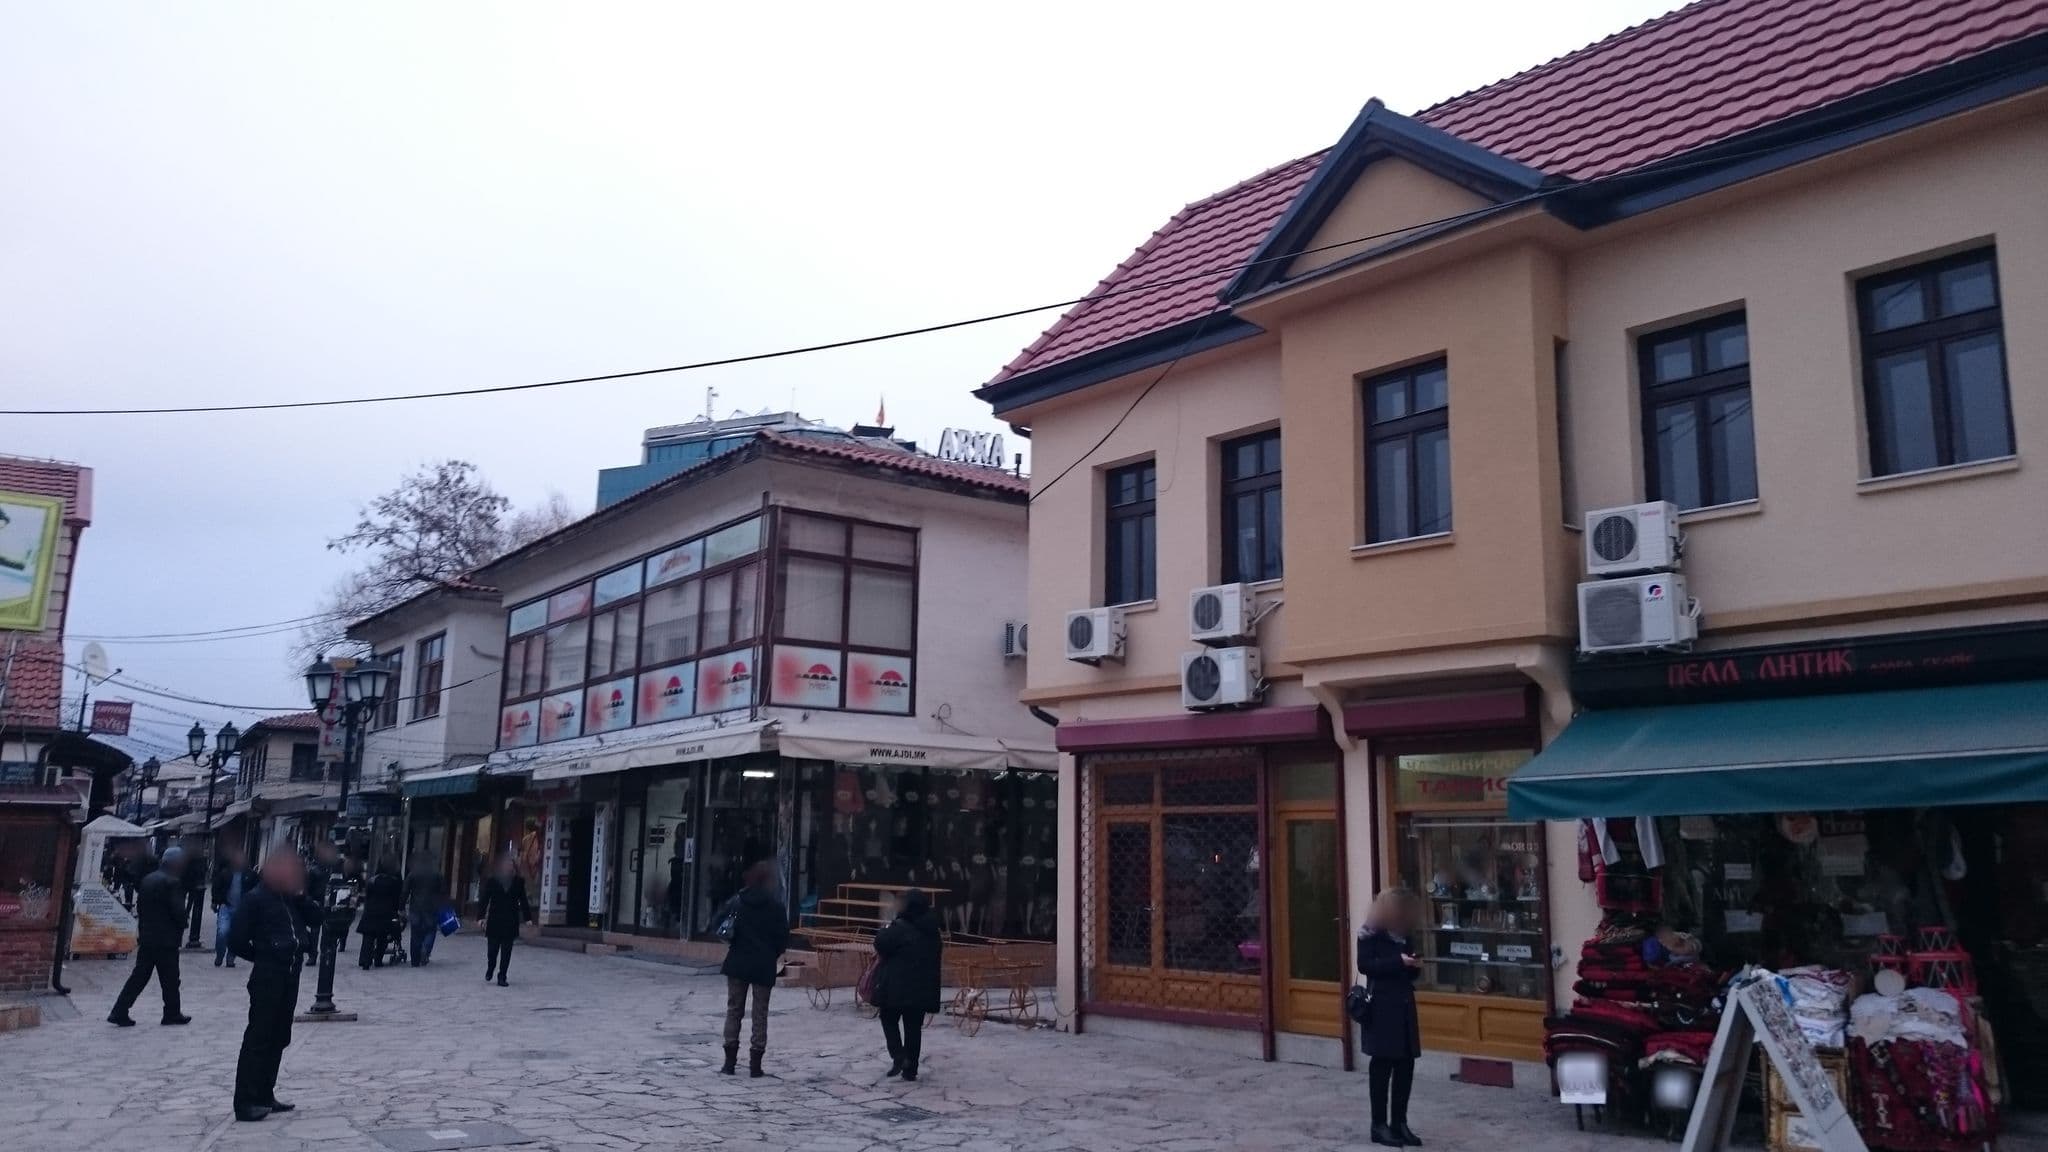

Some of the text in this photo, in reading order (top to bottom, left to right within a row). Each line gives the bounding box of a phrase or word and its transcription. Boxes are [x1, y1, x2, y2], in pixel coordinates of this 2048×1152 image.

[938, 427, 1006, 467] ARKA
[870, 748, 927, 760] WWW.AJDI.MK
[543, 819, 553, 905] HOTEL
